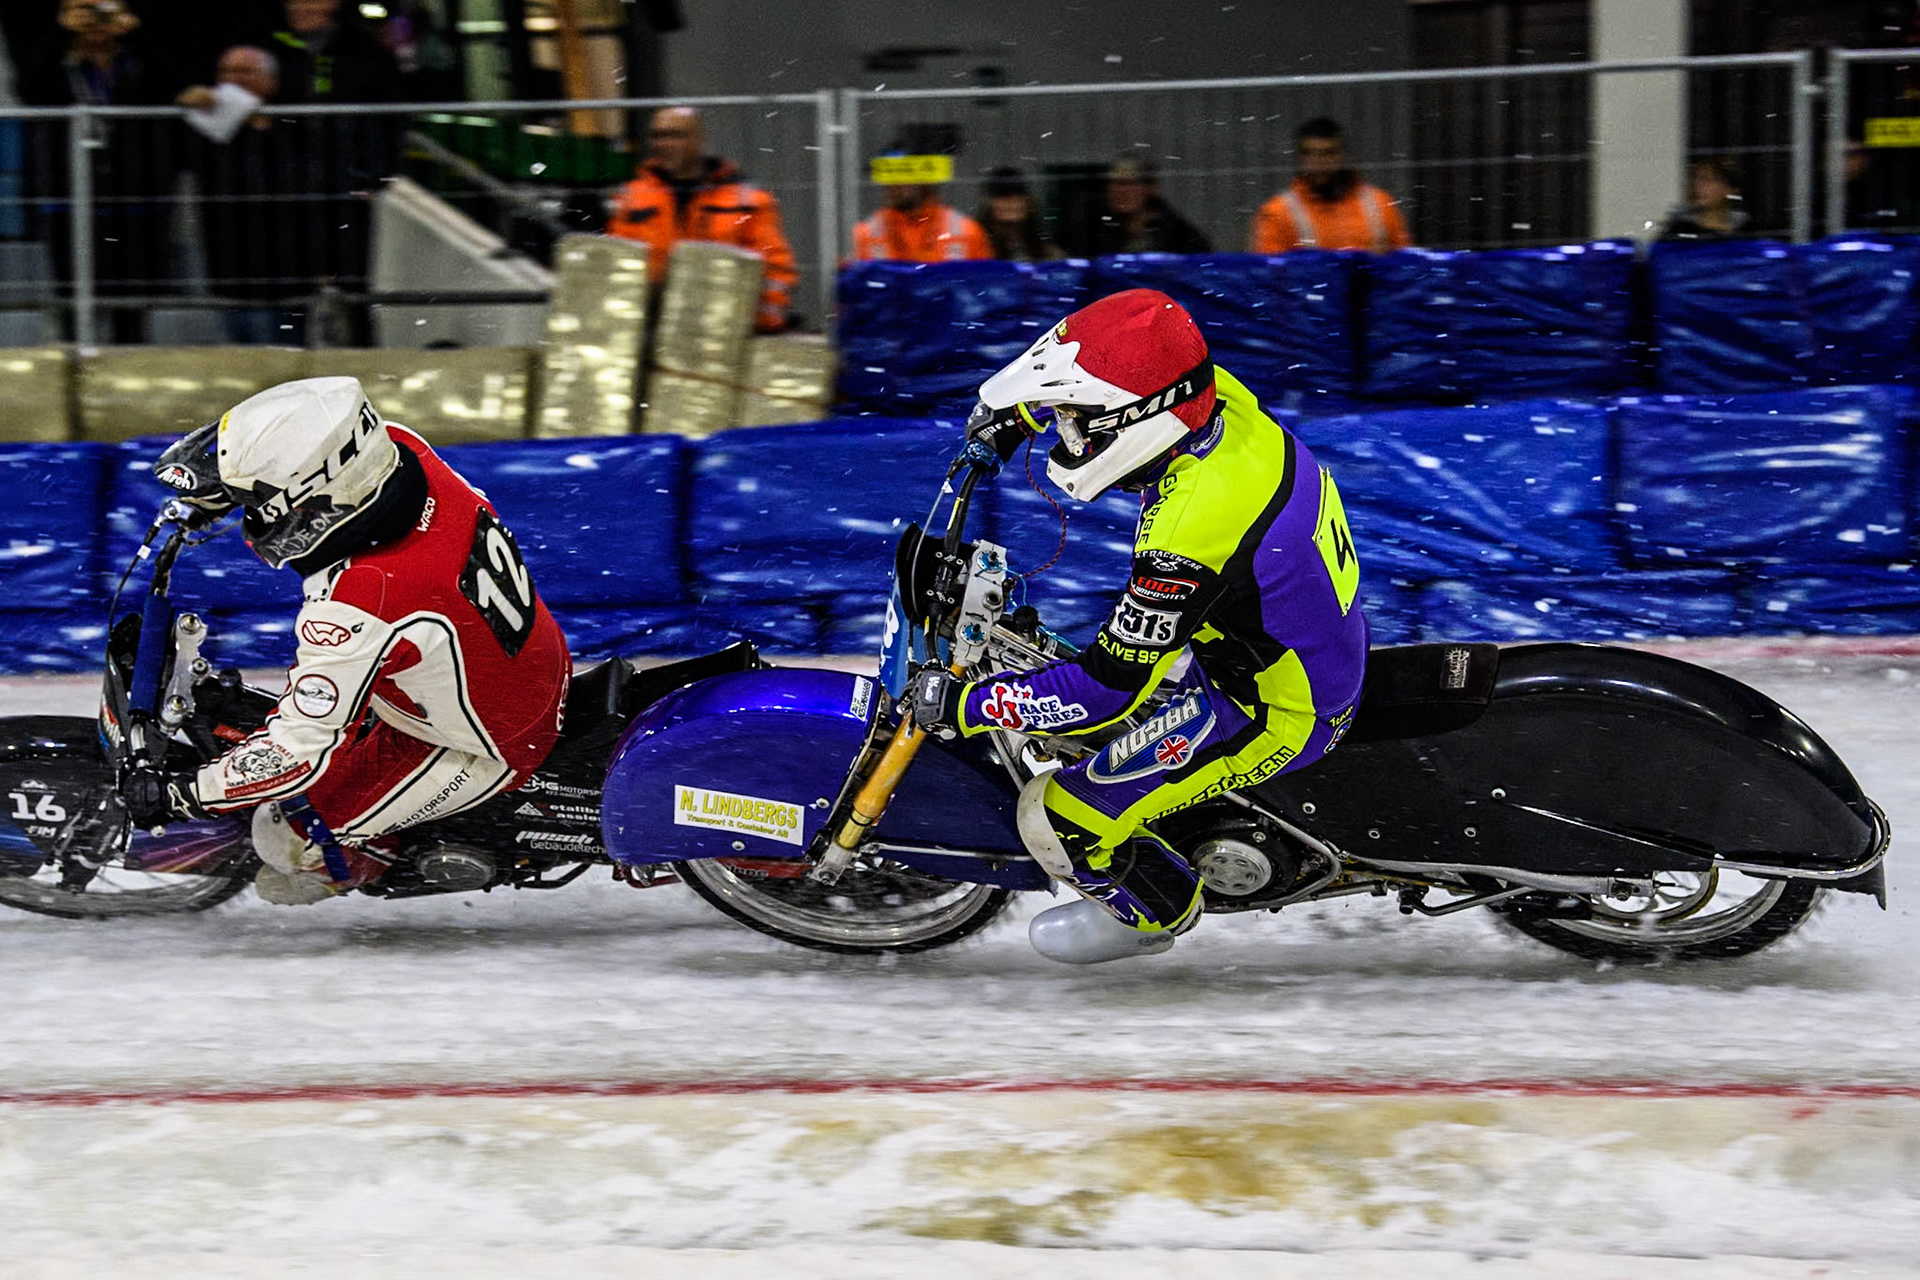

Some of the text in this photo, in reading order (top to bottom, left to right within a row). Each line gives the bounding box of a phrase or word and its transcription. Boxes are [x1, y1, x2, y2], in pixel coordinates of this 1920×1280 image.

[417, 497, 436, 532] WACO
[1331, 517, 1356, 573] 4
[476, 527, 530, 632] 12
[1137, 576, 1183, 593] EDGE
[1098, 631, 1135, 661] CLIVE
[1138, 650, 1159, 664] 99
[1019, 699, 1061, 716] RACE
[8, 792, 66, 822] 16
[400, 768, 471, 828] MOTORSPORT
[559, 785, 601, 797] MOTORSP
[680, 789, 798, 829] N. LINDBERGS
[687, 814, 726, 826] Transport
[736, 821, 775, 835] Container
[776, 829, 789, 838] AB
